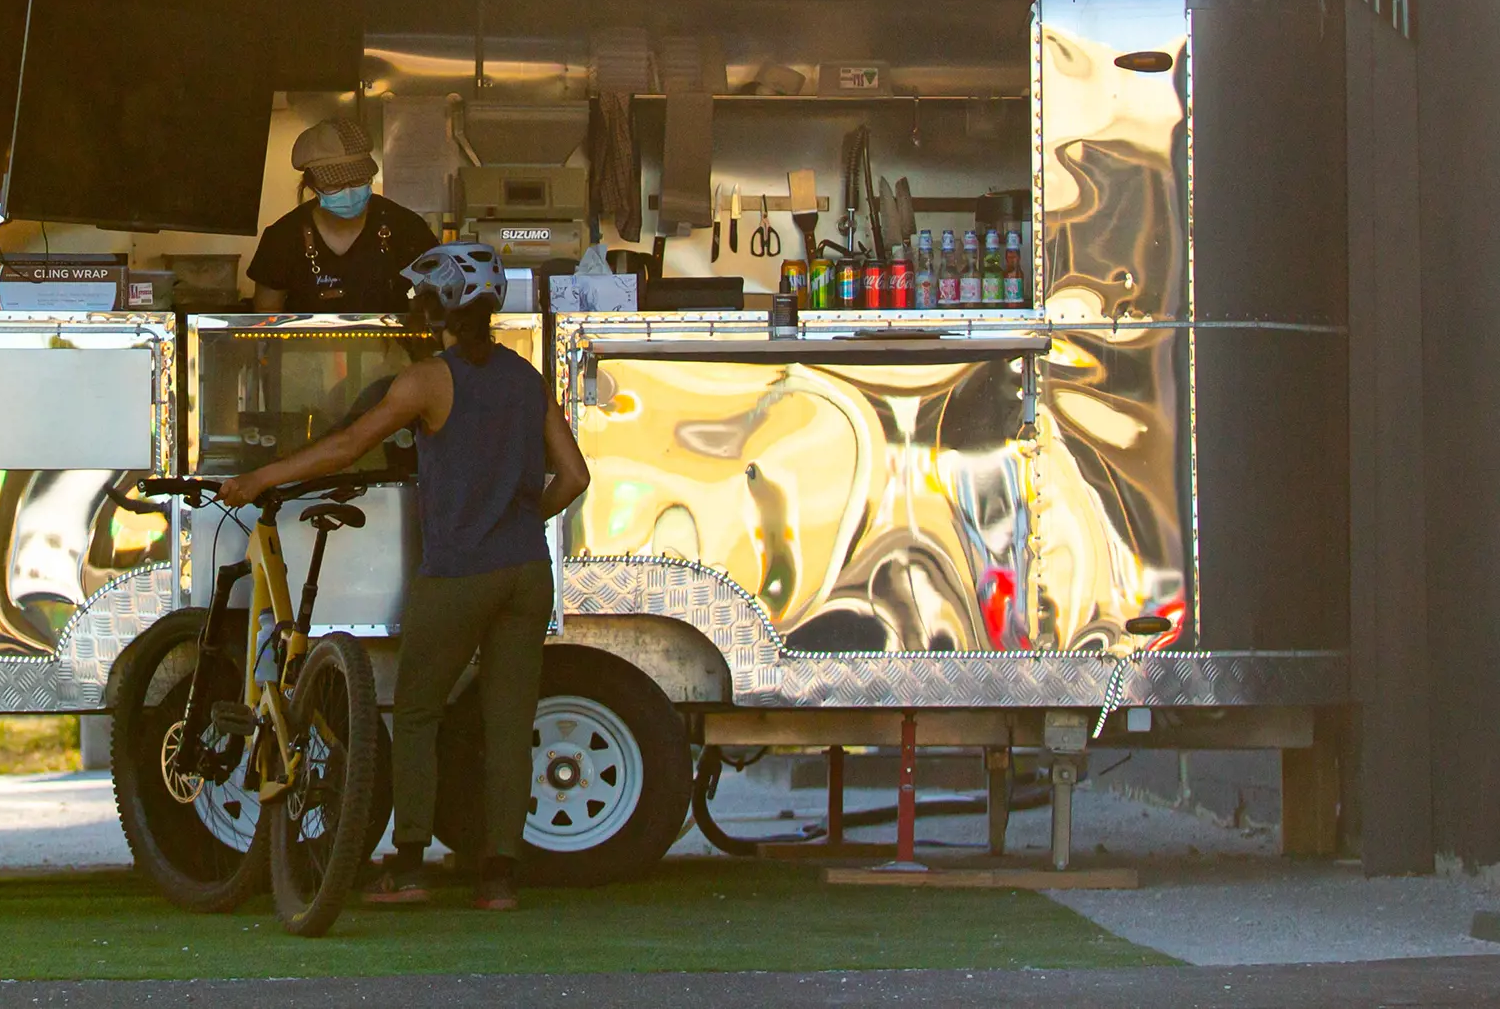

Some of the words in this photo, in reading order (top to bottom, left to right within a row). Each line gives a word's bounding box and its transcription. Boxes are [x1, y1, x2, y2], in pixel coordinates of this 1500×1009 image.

[502, 229, 549, 240] SUZUMO
[34, 269, 69, 279] CLING
[72, 269, 109, 279] WRAP
